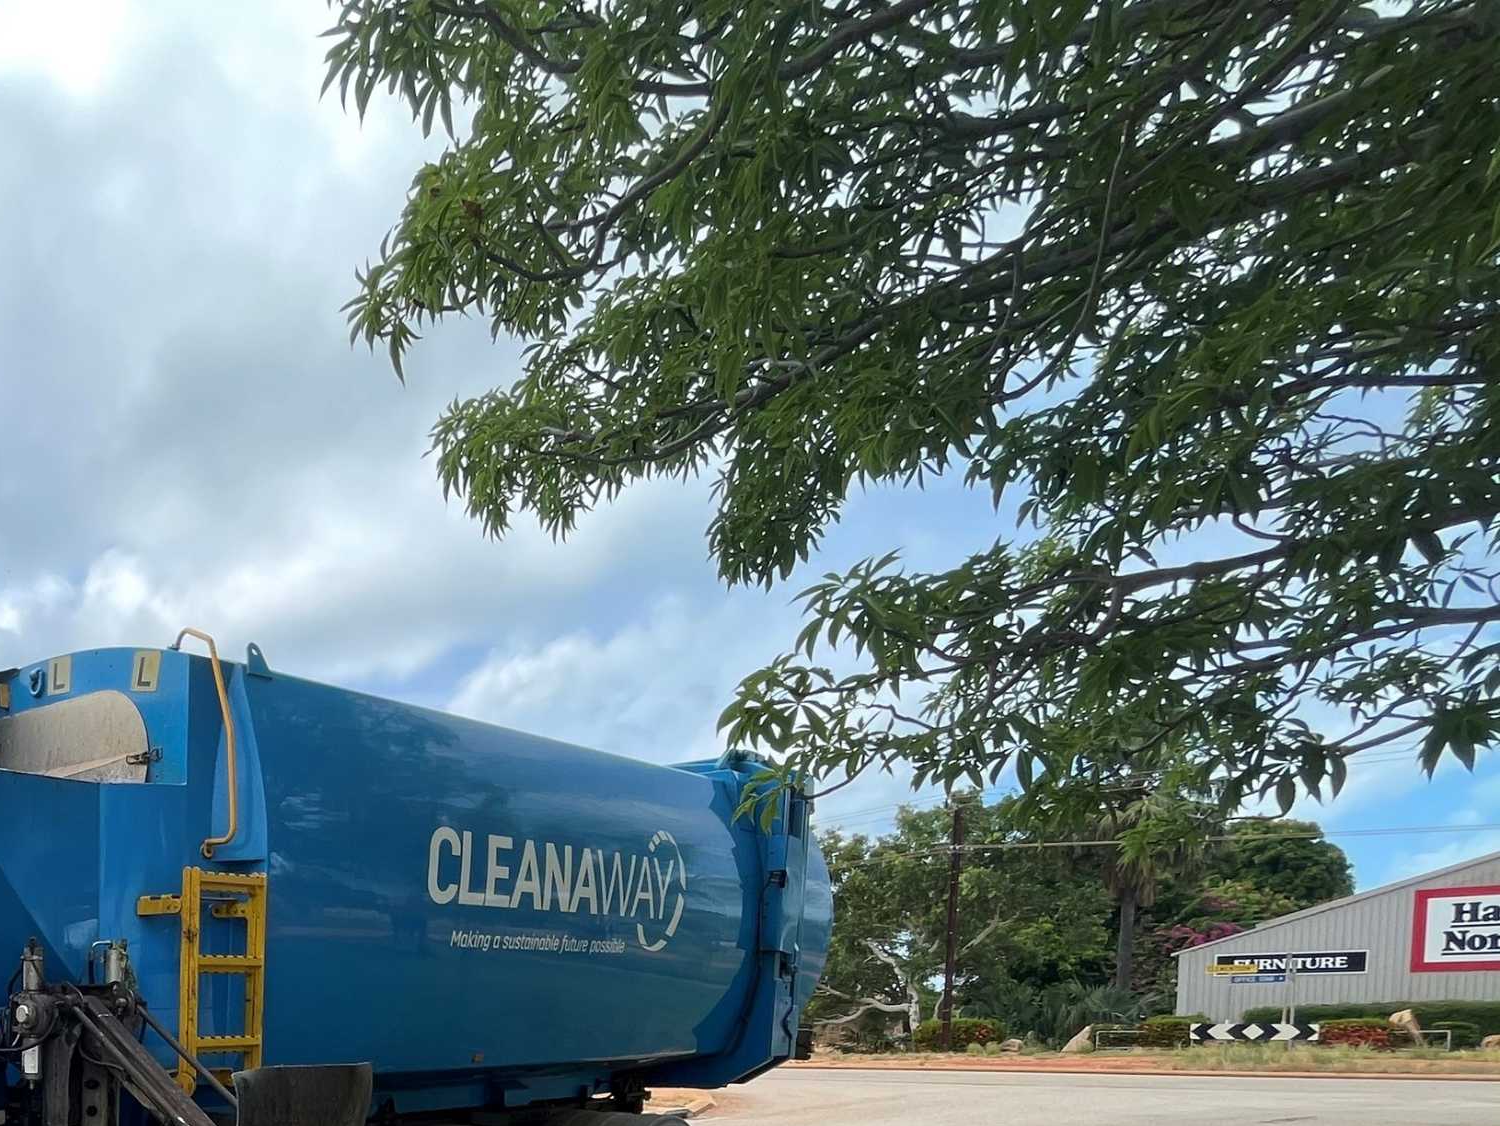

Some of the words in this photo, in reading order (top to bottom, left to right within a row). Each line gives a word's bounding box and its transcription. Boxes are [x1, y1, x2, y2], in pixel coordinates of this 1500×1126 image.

[428, 826, 674, 920] CLEANAWAY
[1451, 901, 1500, 923] Ha
[450, 930, 491, 951] Making
[493, 936, 501, 949] a
[502, 933, 560, 951] sustainable
[559, 935, 589, 954] future
[590, 938, 626, 955] possible
